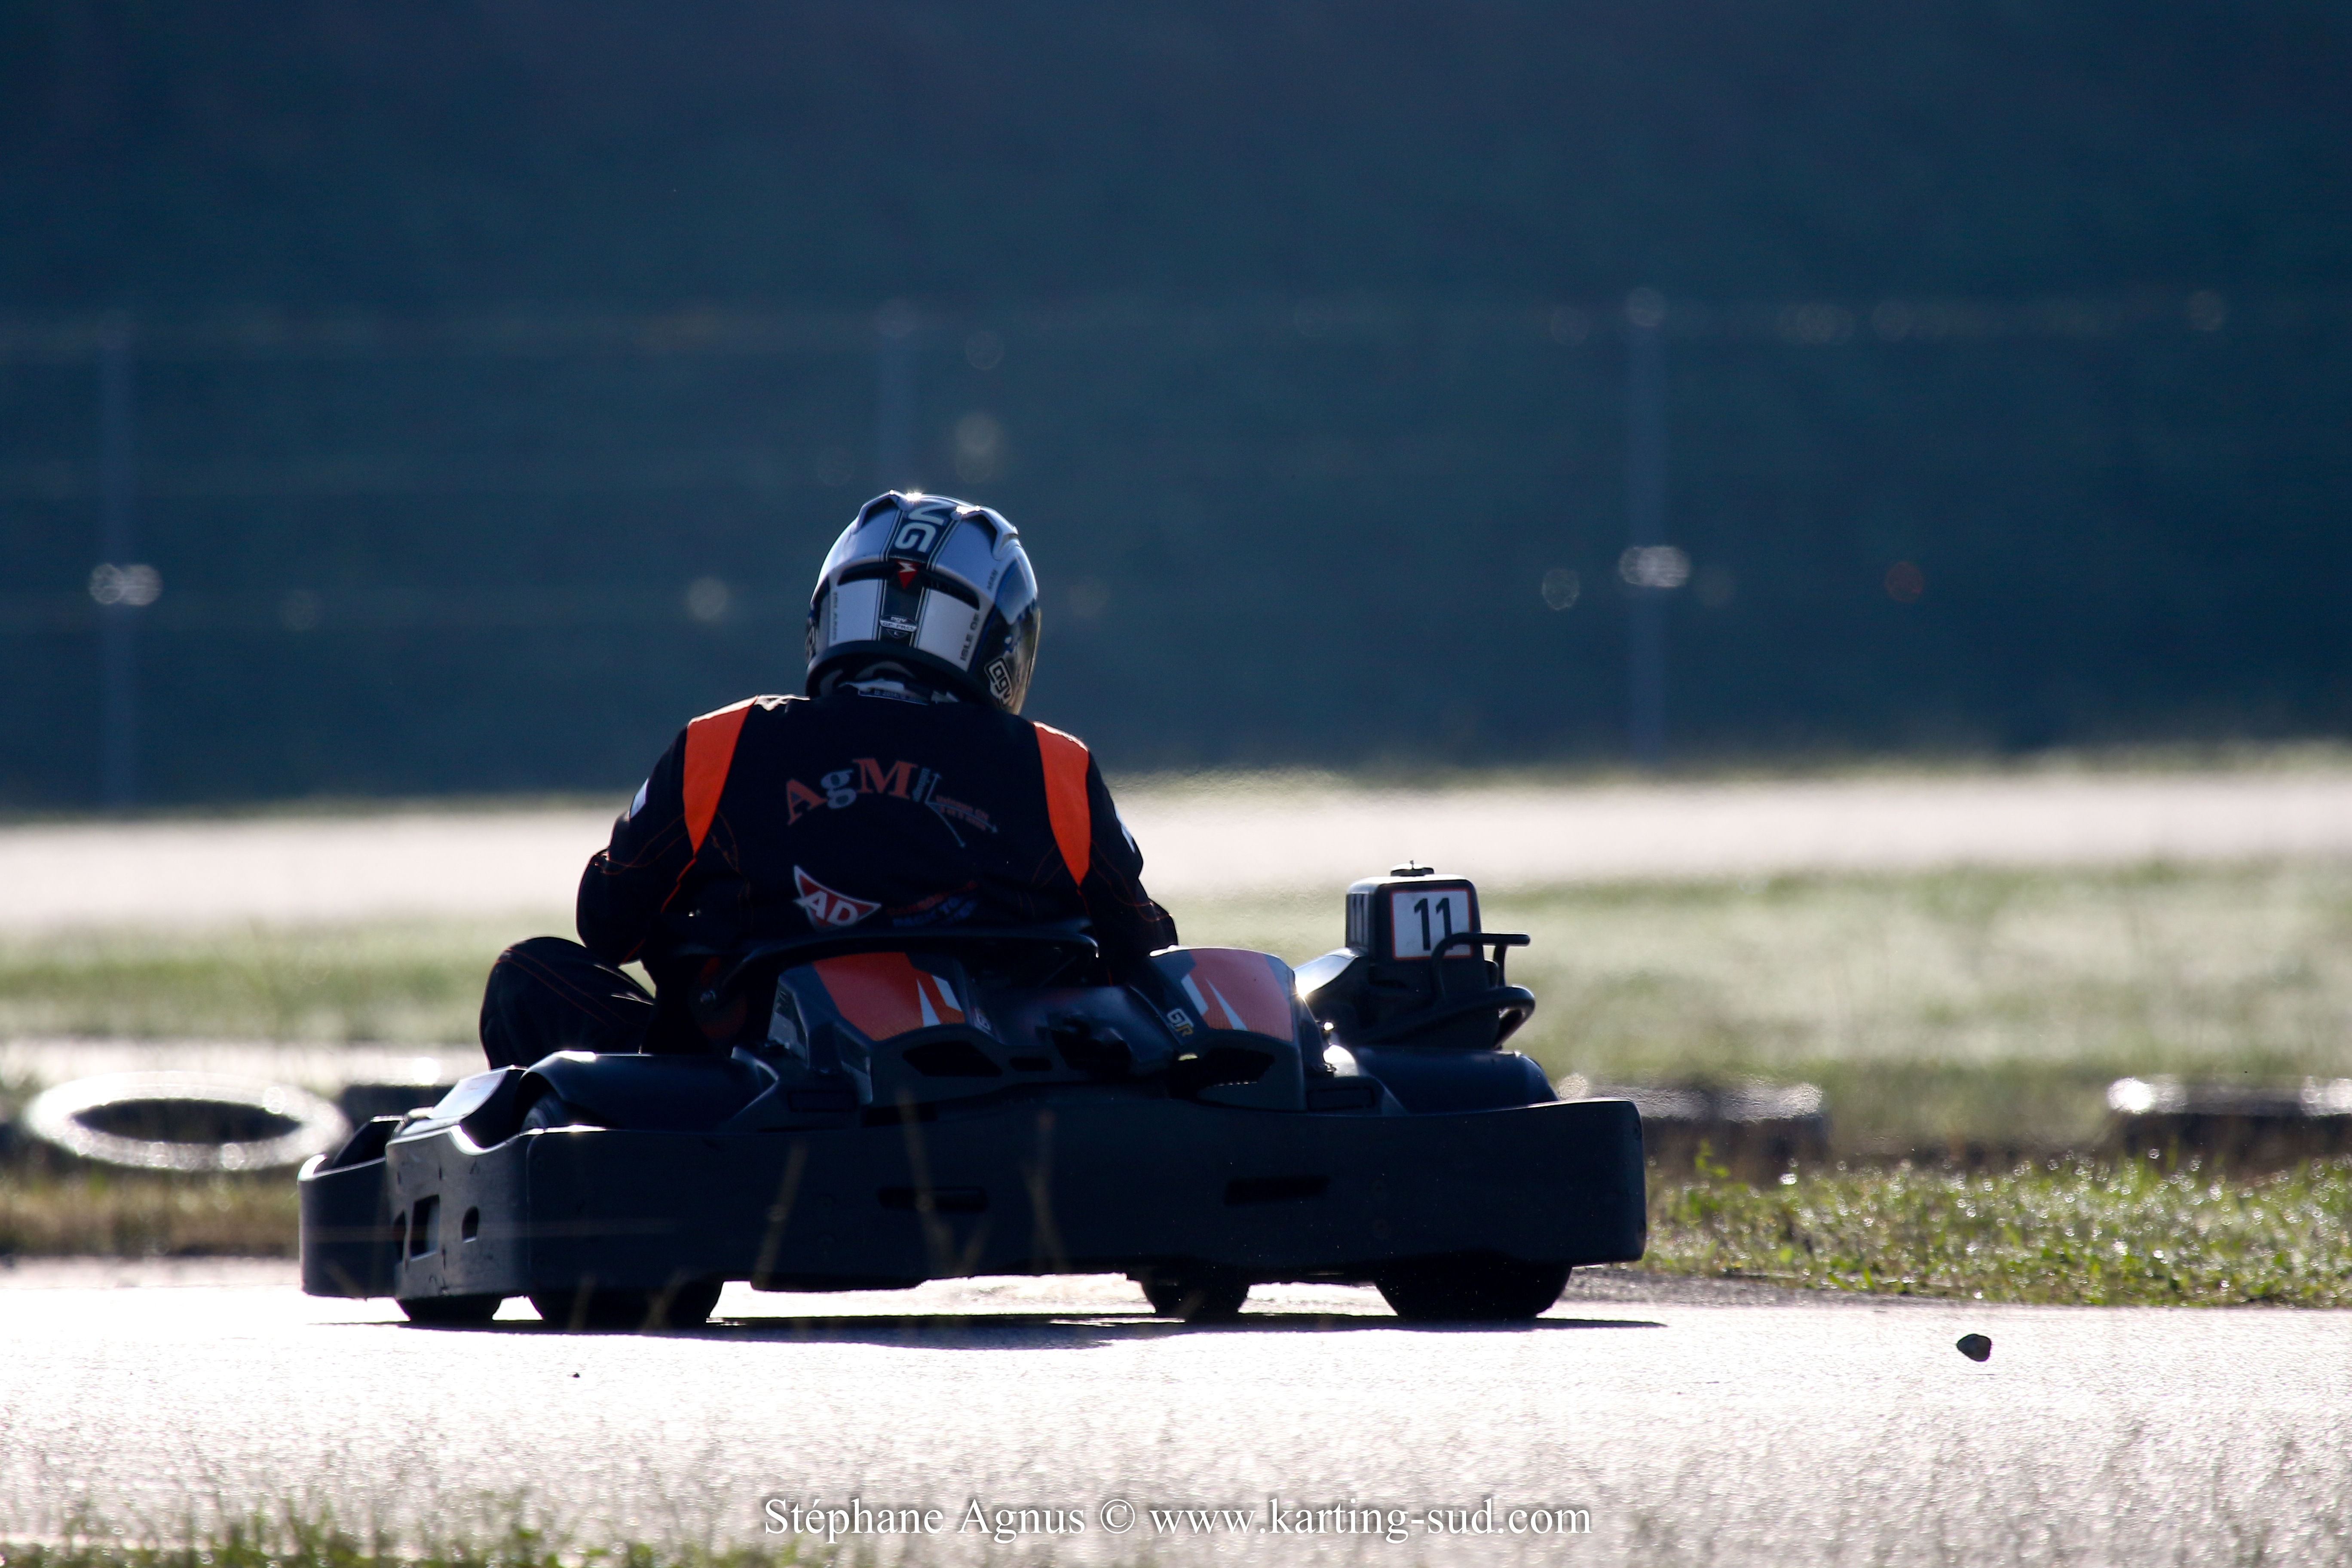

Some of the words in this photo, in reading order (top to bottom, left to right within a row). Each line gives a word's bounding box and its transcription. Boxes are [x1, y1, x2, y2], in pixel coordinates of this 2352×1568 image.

[793, 890, 859, 925] AD
[1414, 897, 1453, 951] 11
[1167, 1008, 1194, 1037] GTR
